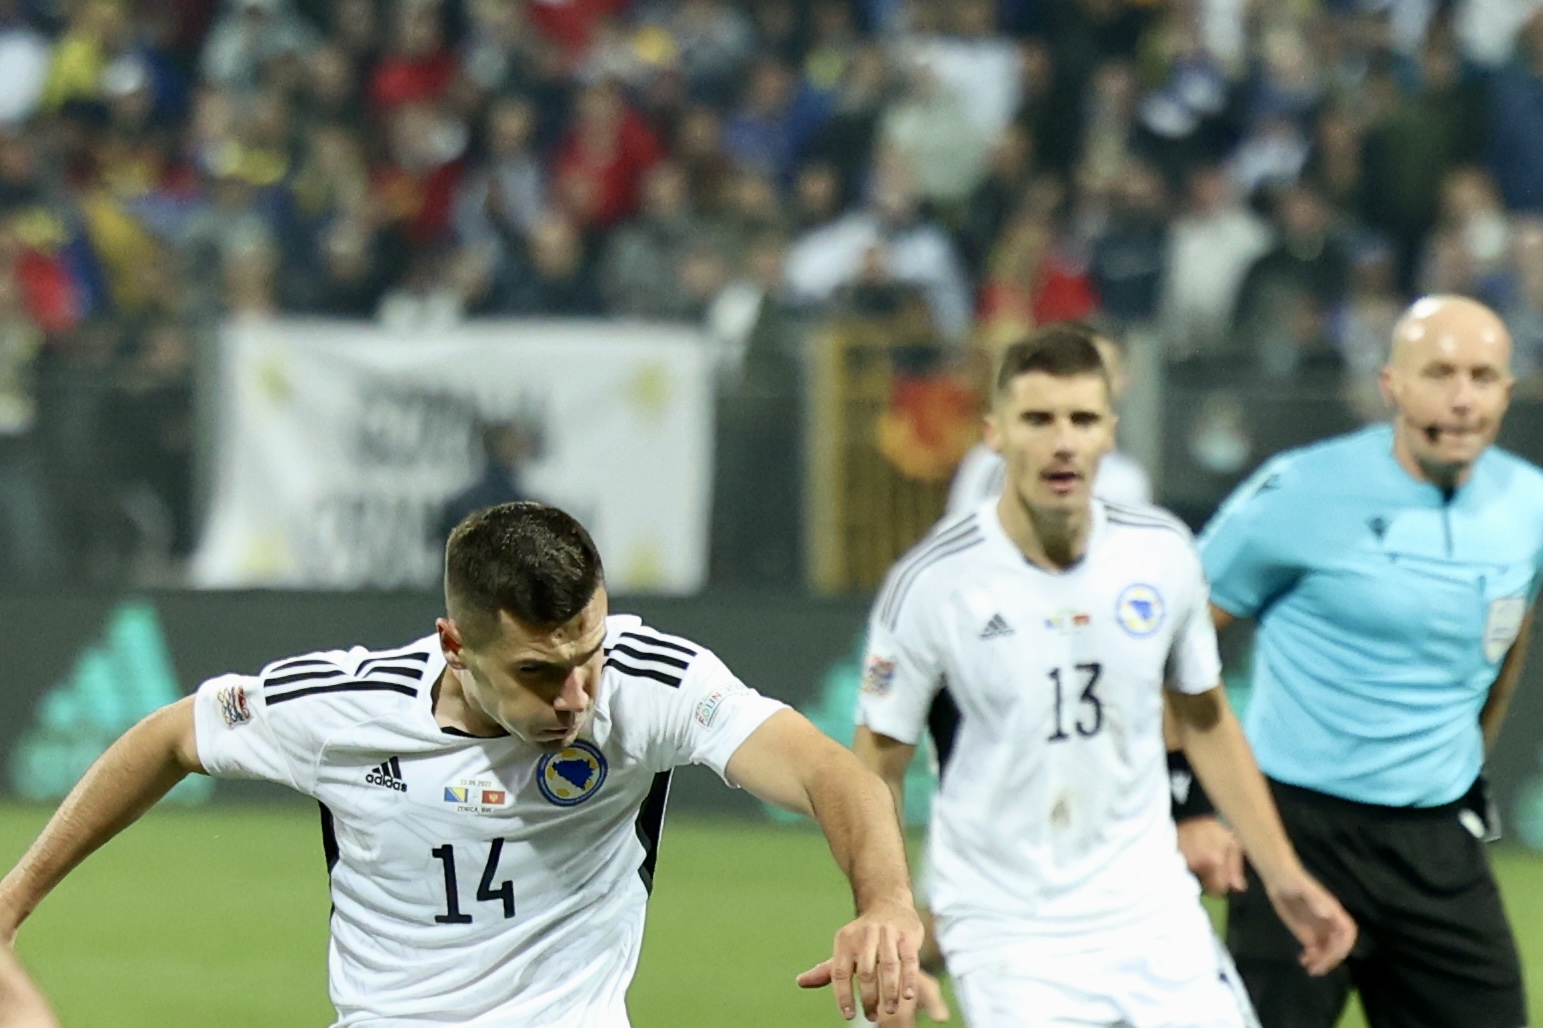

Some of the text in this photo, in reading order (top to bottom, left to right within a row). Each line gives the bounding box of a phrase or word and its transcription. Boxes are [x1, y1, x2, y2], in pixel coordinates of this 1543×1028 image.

[1046, 662, 1103, 744] 13
[365, 773, 408, 792] adidas
[431, 836, 516, 924] 14
